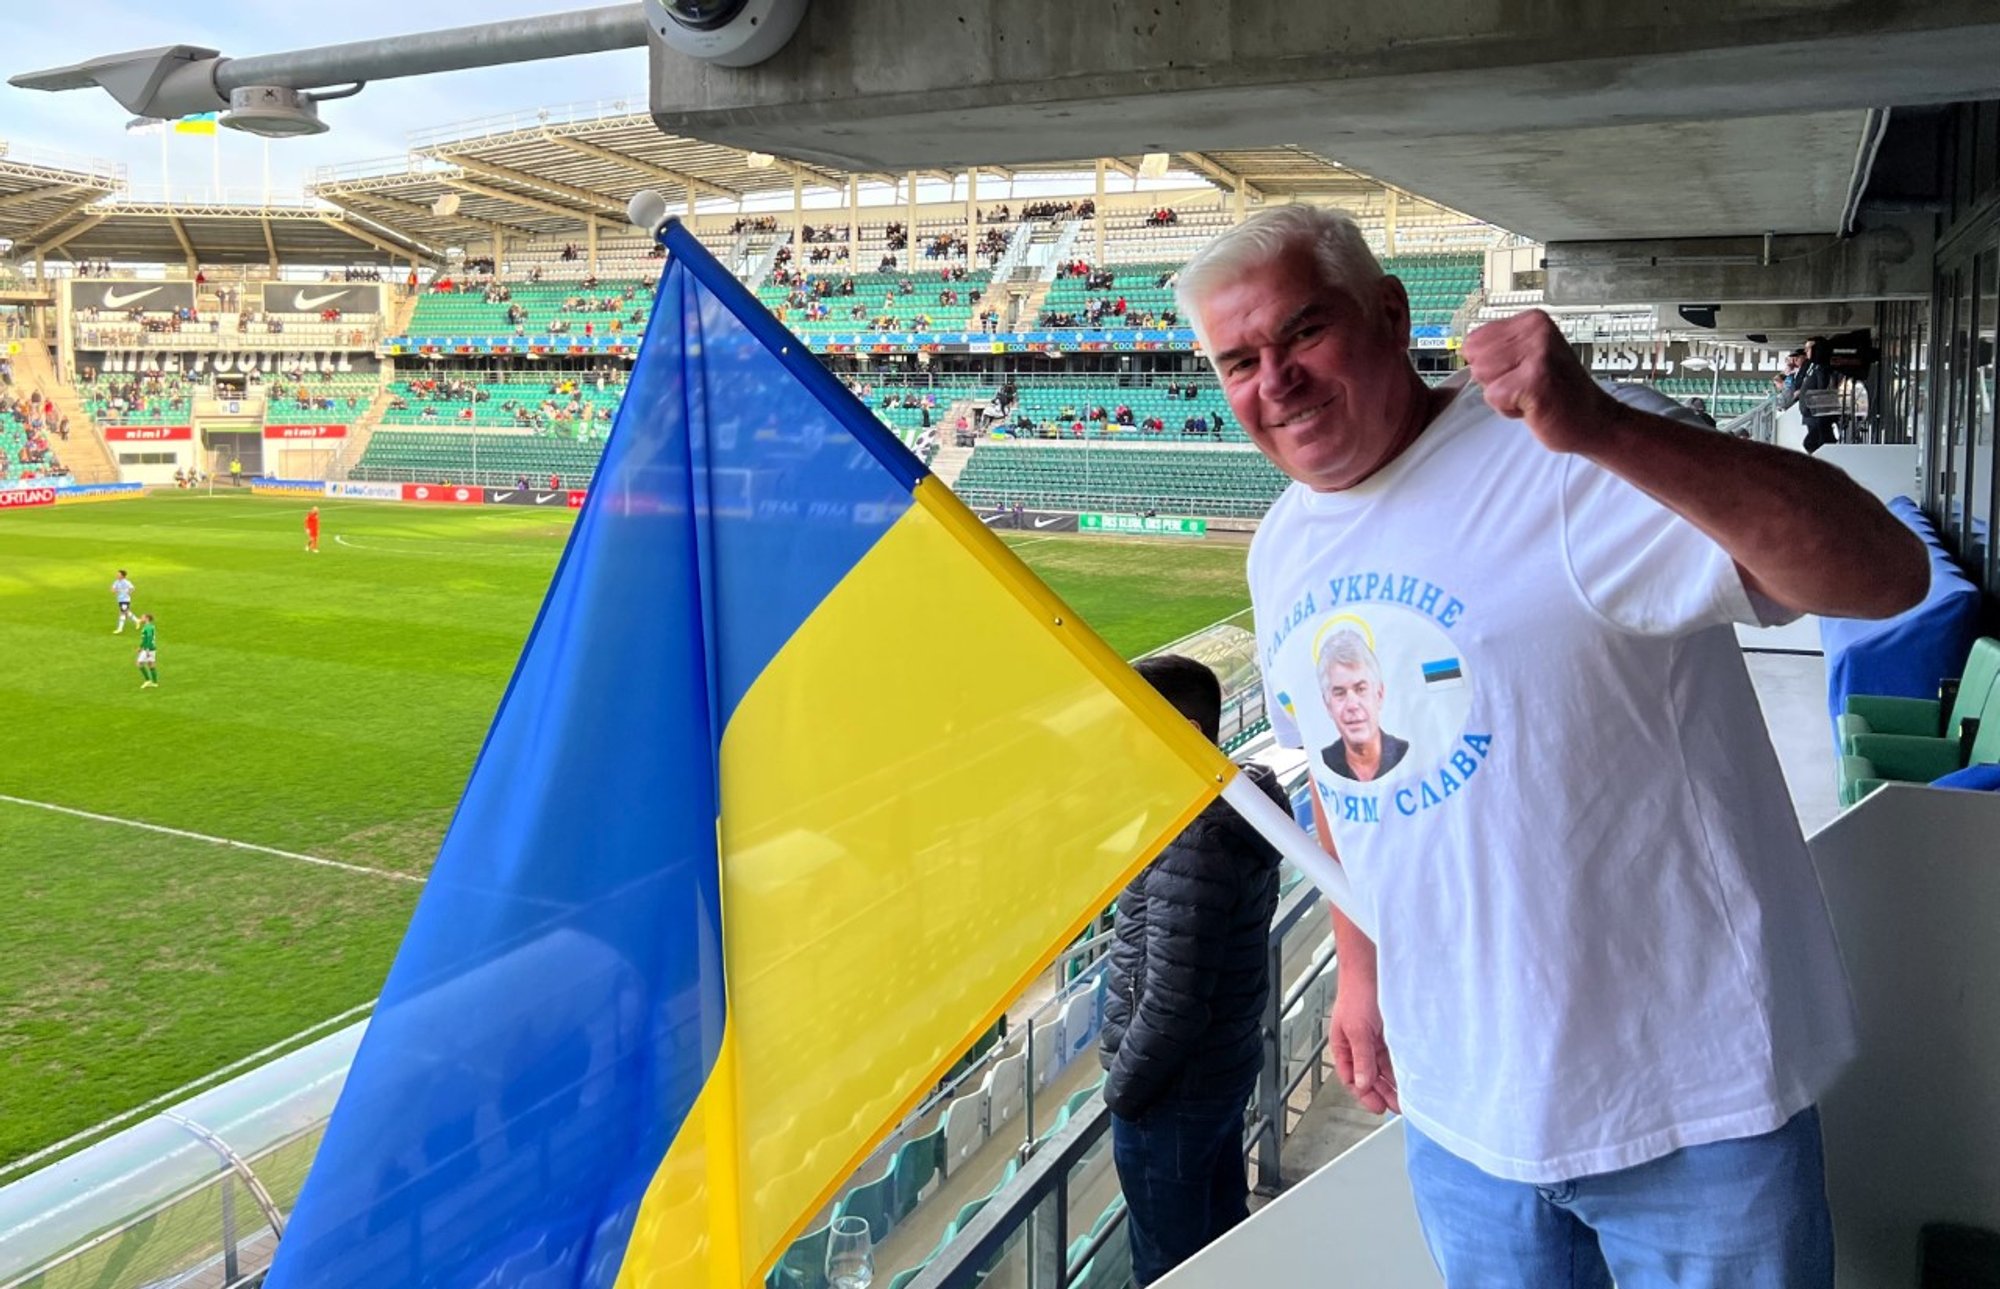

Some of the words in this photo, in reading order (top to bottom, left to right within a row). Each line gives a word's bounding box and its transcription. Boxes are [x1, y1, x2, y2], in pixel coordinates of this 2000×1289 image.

[103, 351, 180, 372] NIKE
[195, 351, 352, 372] FOOTBALL
[1329, 573, 1465, 629] УКРАИНЕ
[1395, 731, 1493, 816] СЛАВА
